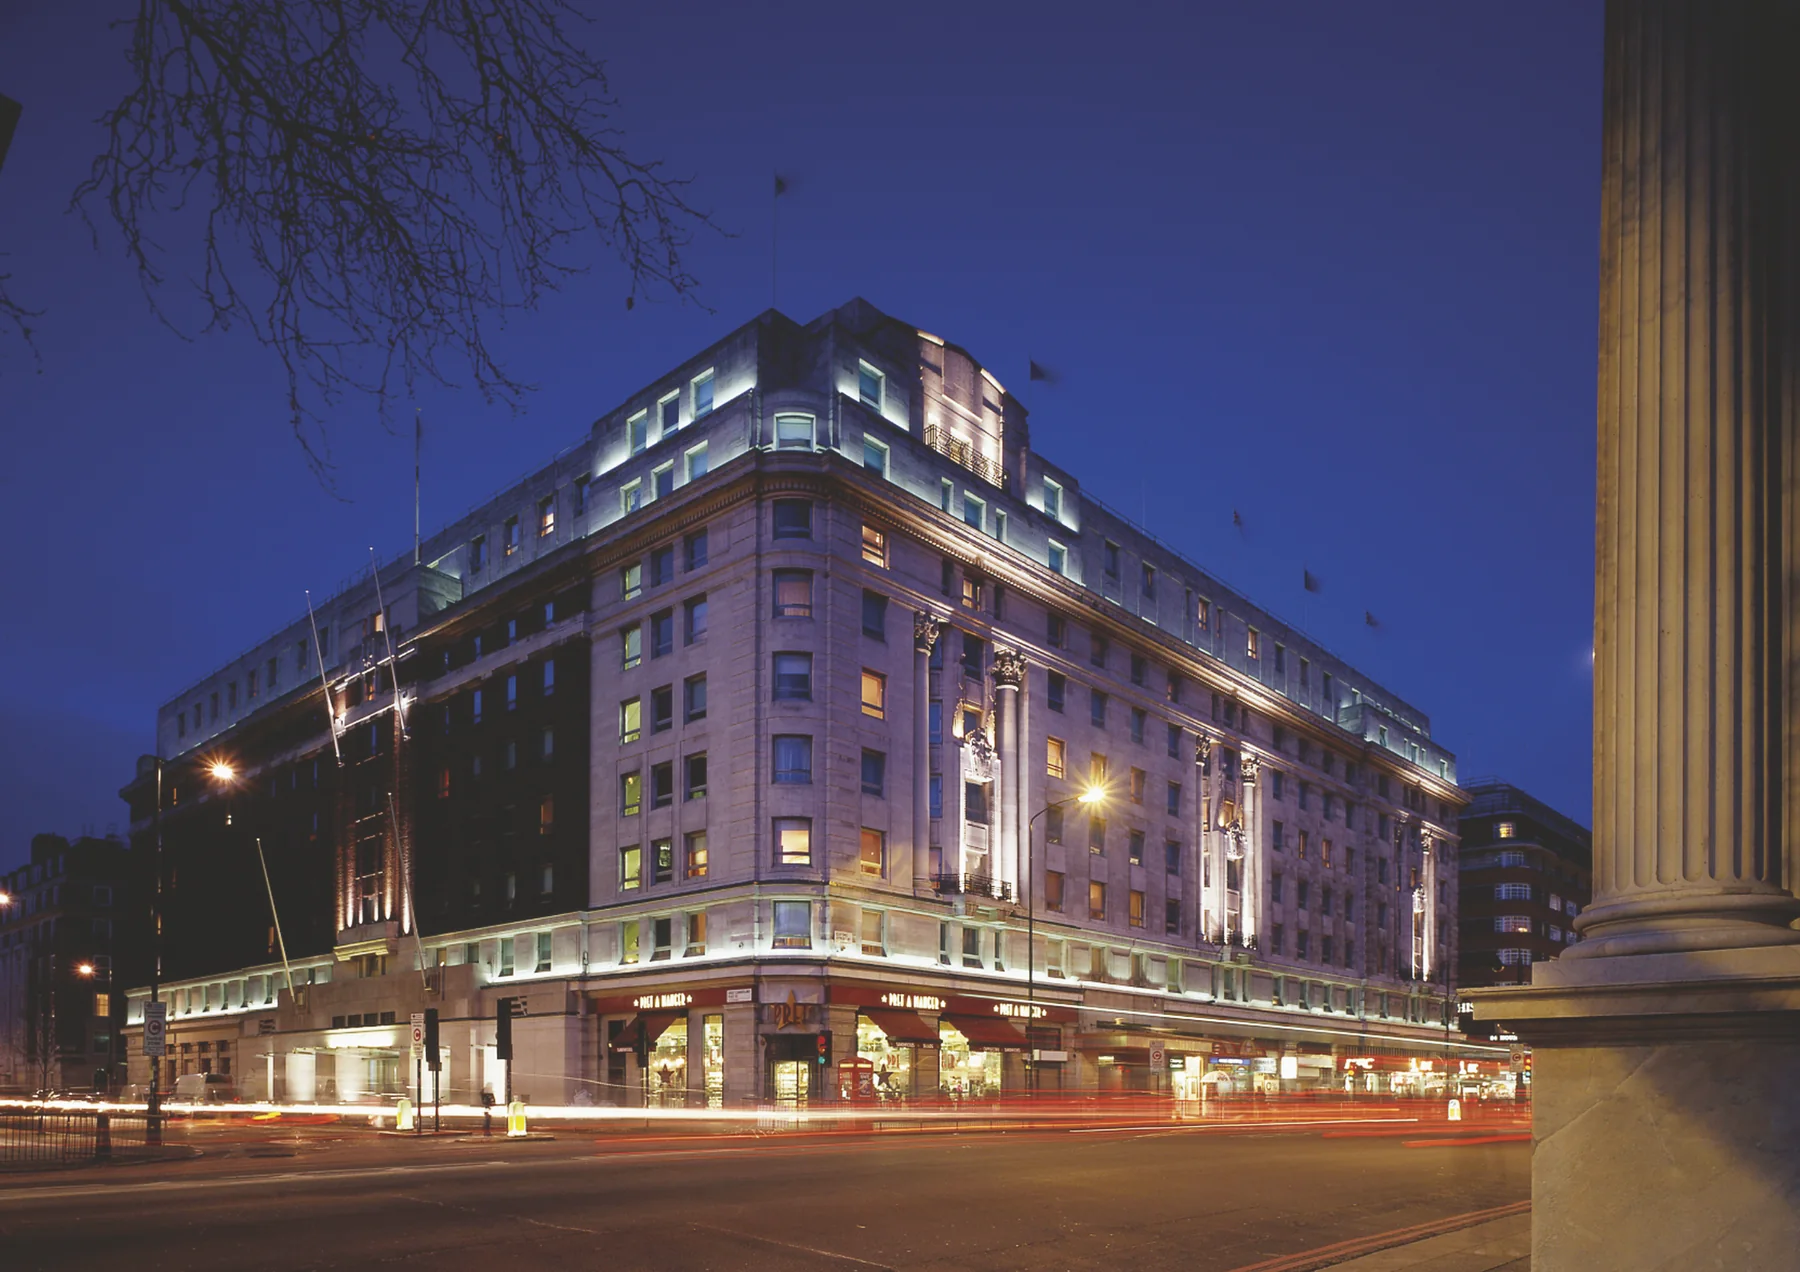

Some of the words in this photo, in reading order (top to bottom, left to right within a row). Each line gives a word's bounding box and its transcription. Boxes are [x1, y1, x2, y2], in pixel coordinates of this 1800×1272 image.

[640, 995, 653, 1009] PRET
[654, 995, 660, 1008] A
[889, 993, 904, 1007] PRET
[906, 995, 912, 1007] A
[1000, 1003, 1013, 1016] PRET
[1014, 1005, 1019, 1016] A
